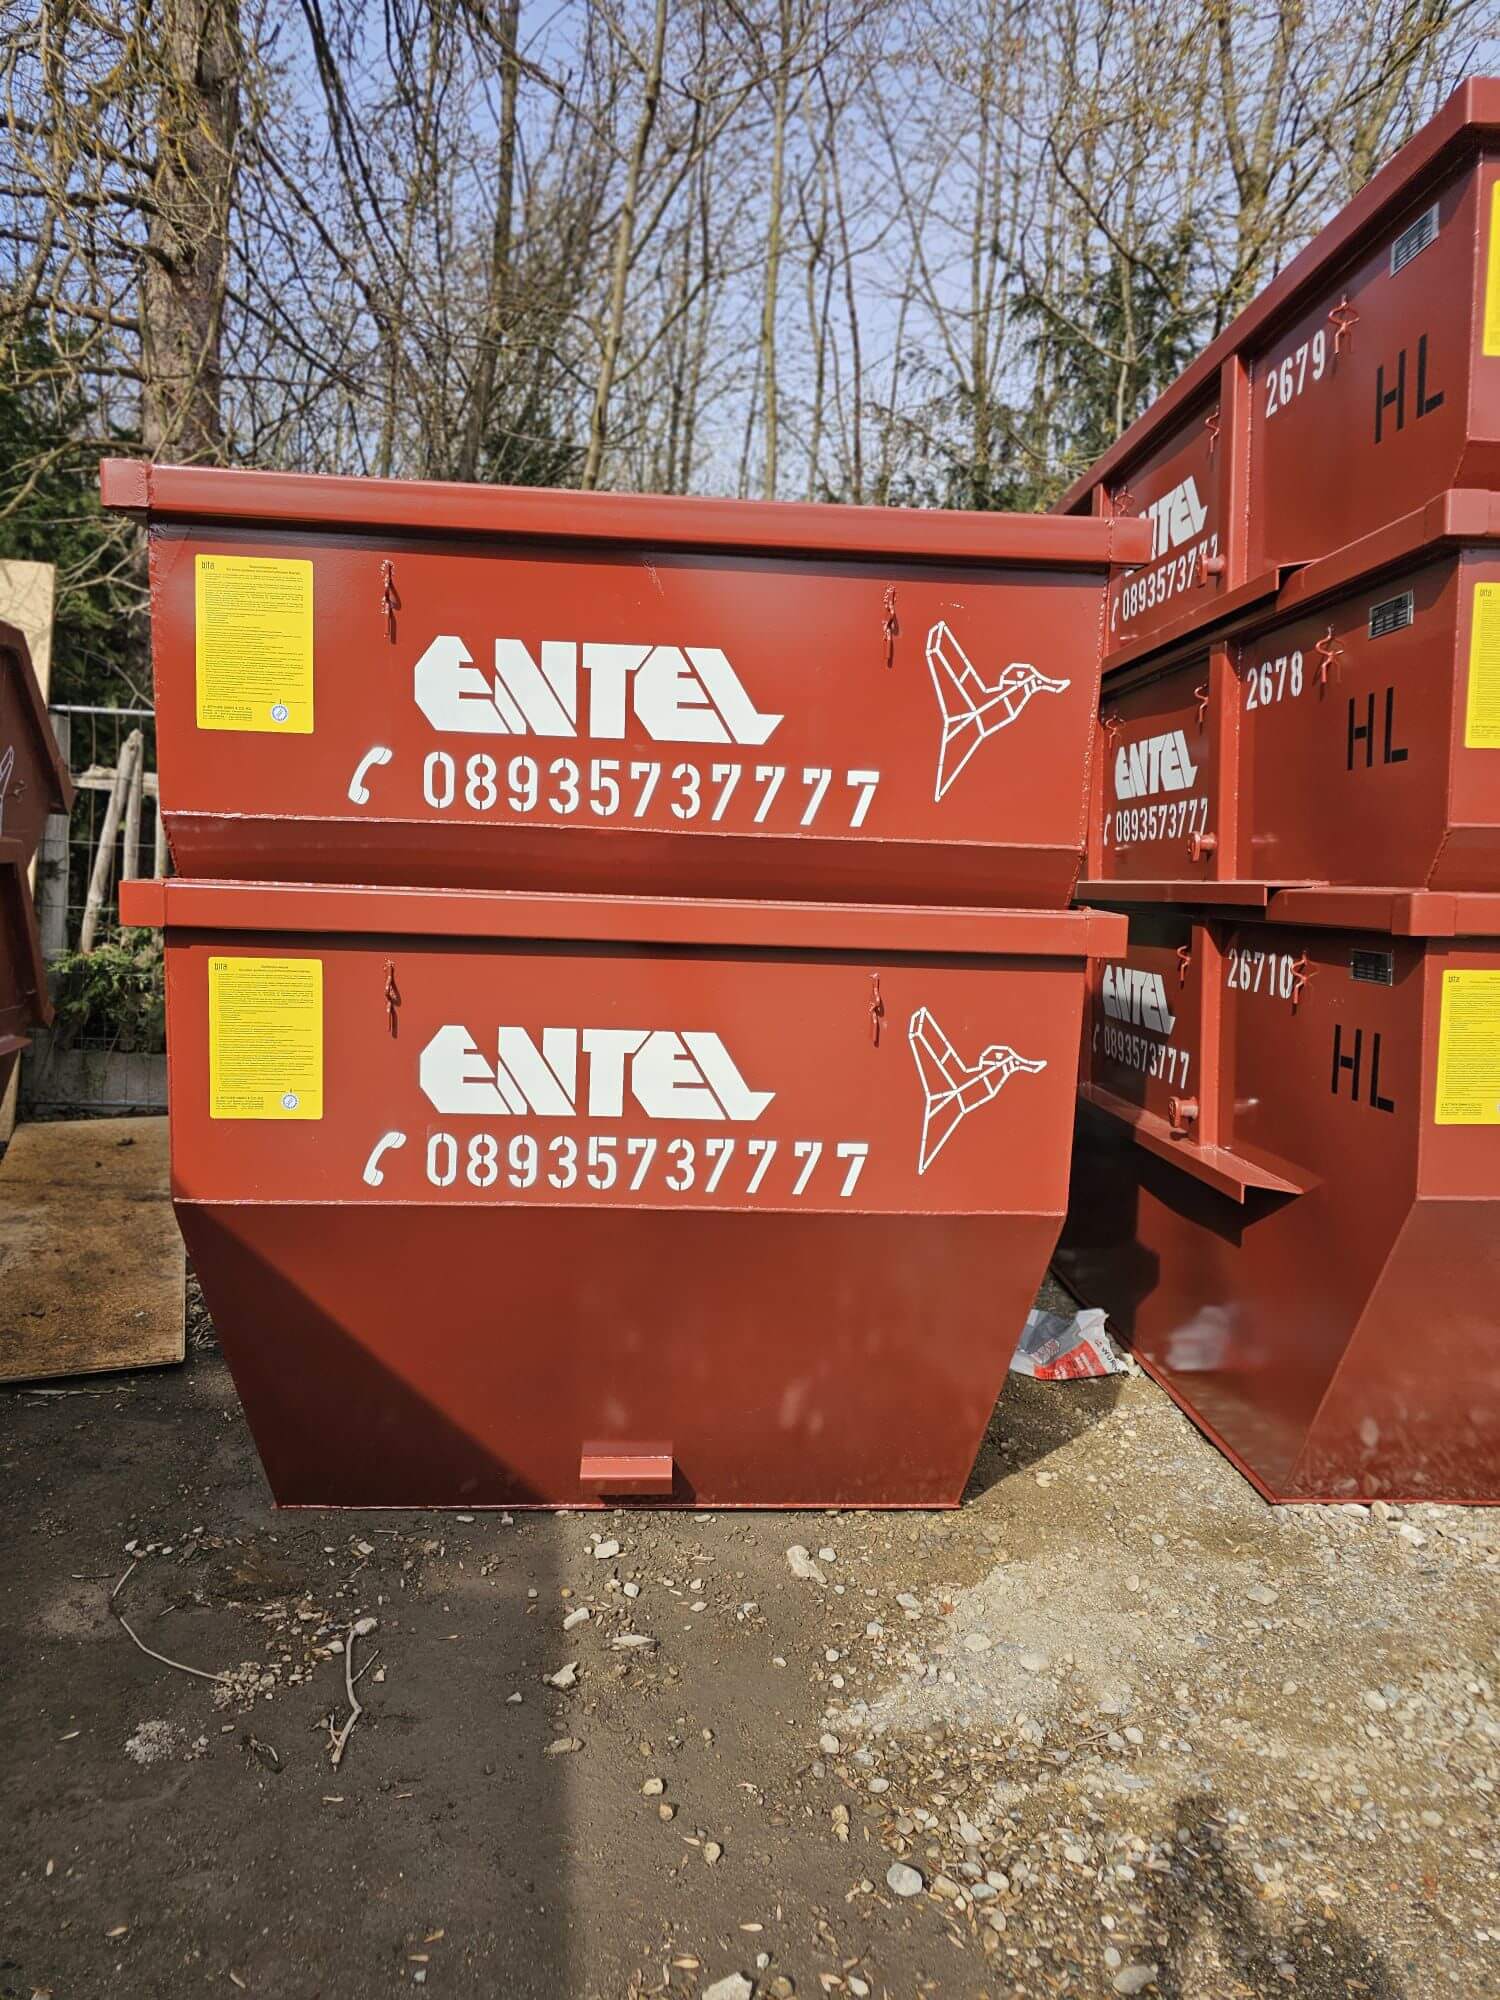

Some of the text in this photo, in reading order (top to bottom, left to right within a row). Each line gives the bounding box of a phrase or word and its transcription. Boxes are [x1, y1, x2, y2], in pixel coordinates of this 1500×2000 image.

[1265, 328, 1326, 419] 2679
[1374, 333, 1444, 444] HL
[414, 635, 784, 745] ENTEL
[1246, 650, 1303, 711] 2678
[1115, 729, 1198, 801] ENTEL
[1347, 686, 1408, 771] HL
[423, 751, 880, 827] 08935737777
[1102, 964, 1177, 1036] ENTEL
[1227, 947, 1294, 999] 26710
[420, 1025, 776, 1121] ENTEL
[1331, 1024, 1395, 1113] HL
[427, 1133, 869, 1197] 08935737777
